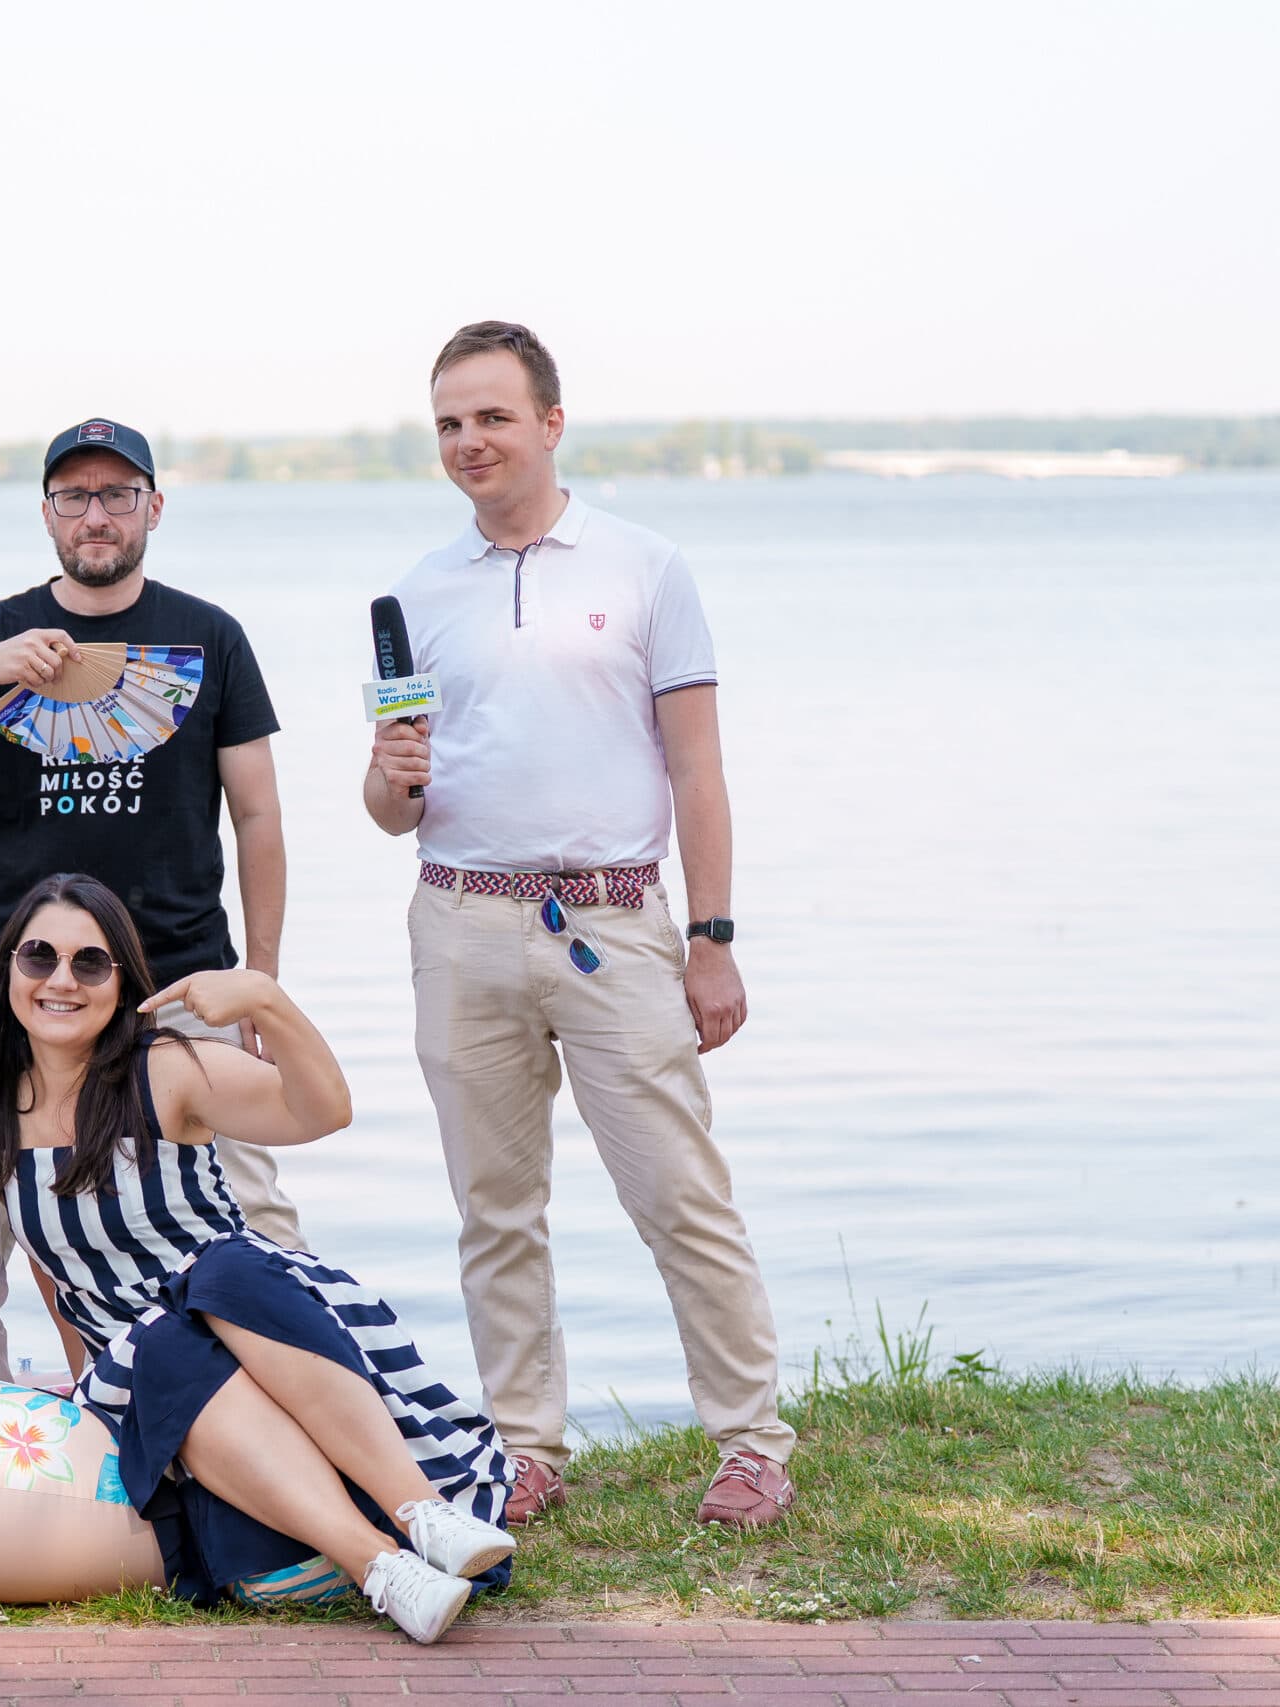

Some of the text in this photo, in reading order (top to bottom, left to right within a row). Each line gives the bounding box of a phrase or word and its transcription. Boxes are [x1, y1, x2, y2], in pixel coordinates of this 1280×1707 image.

[378, 690, 435, 704] Warszawa
[40, 765, 144, 792] MIŁOŚĆ
[39, 790, 141, 816] POKÓJ
